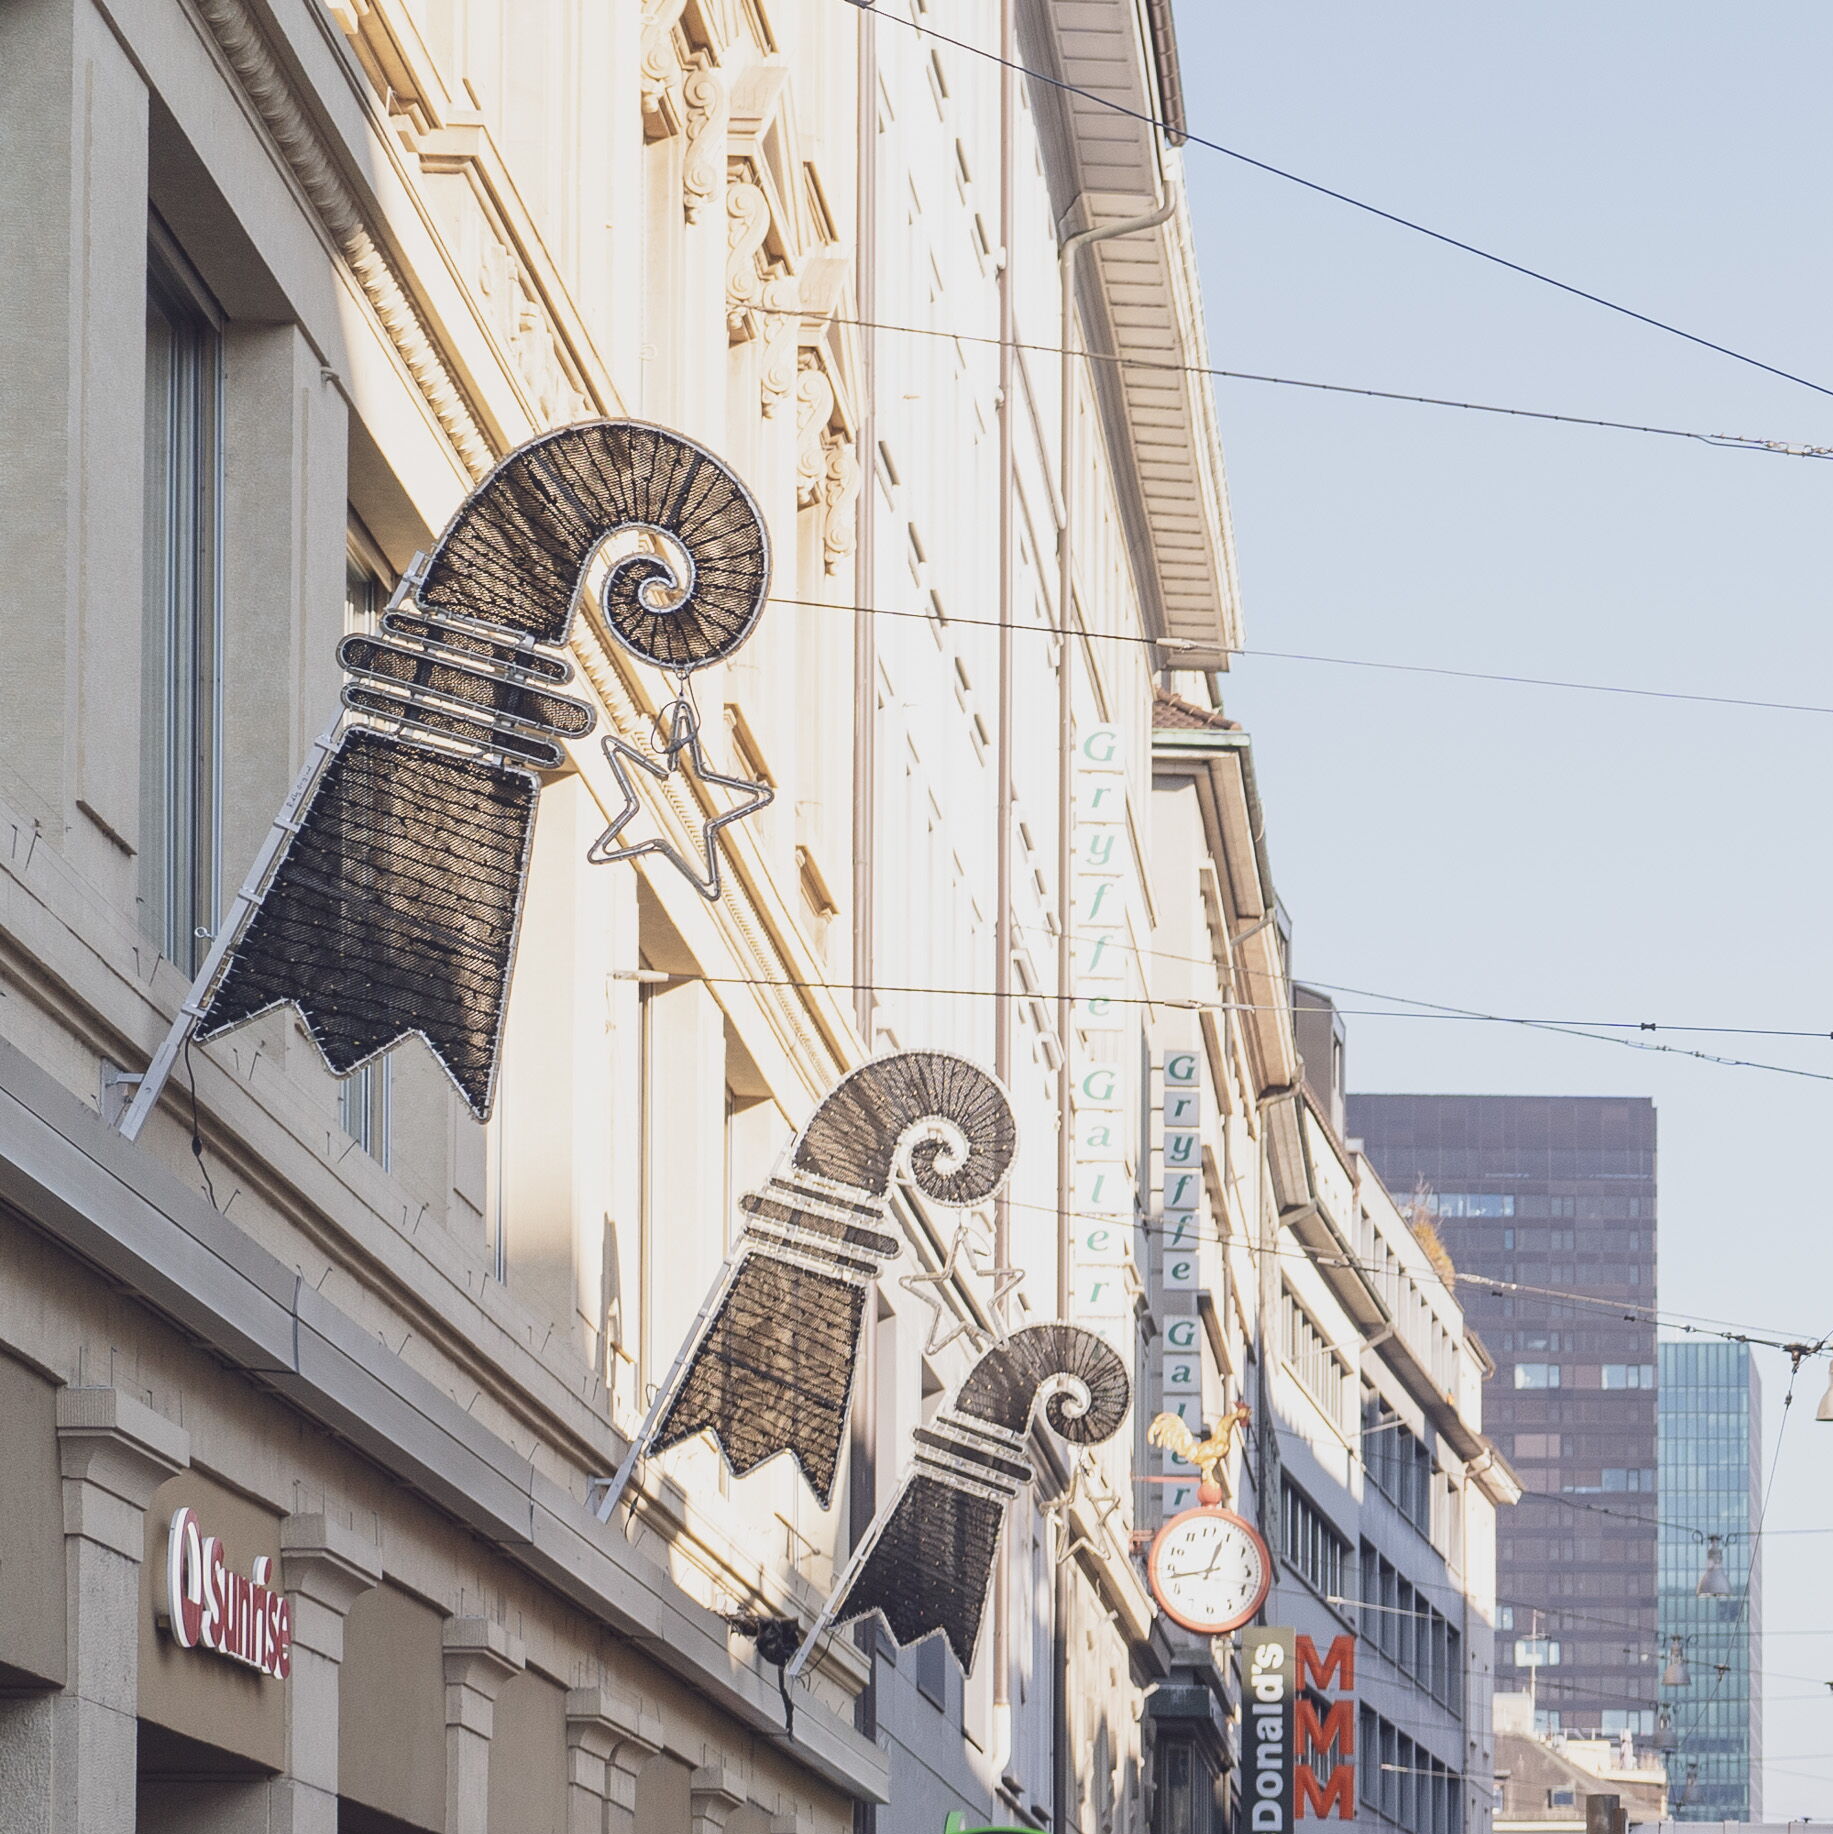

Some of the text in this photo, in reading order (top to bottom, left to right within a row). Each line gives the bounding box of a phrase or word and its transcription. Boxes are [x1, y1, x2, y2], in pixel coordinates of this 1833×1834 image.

[1083, 730, 1115, 1017] Gryffe
[1168, 1054, 1196, 1281] Gryffe
[202, 1536, 292, 1680] Sunrise
